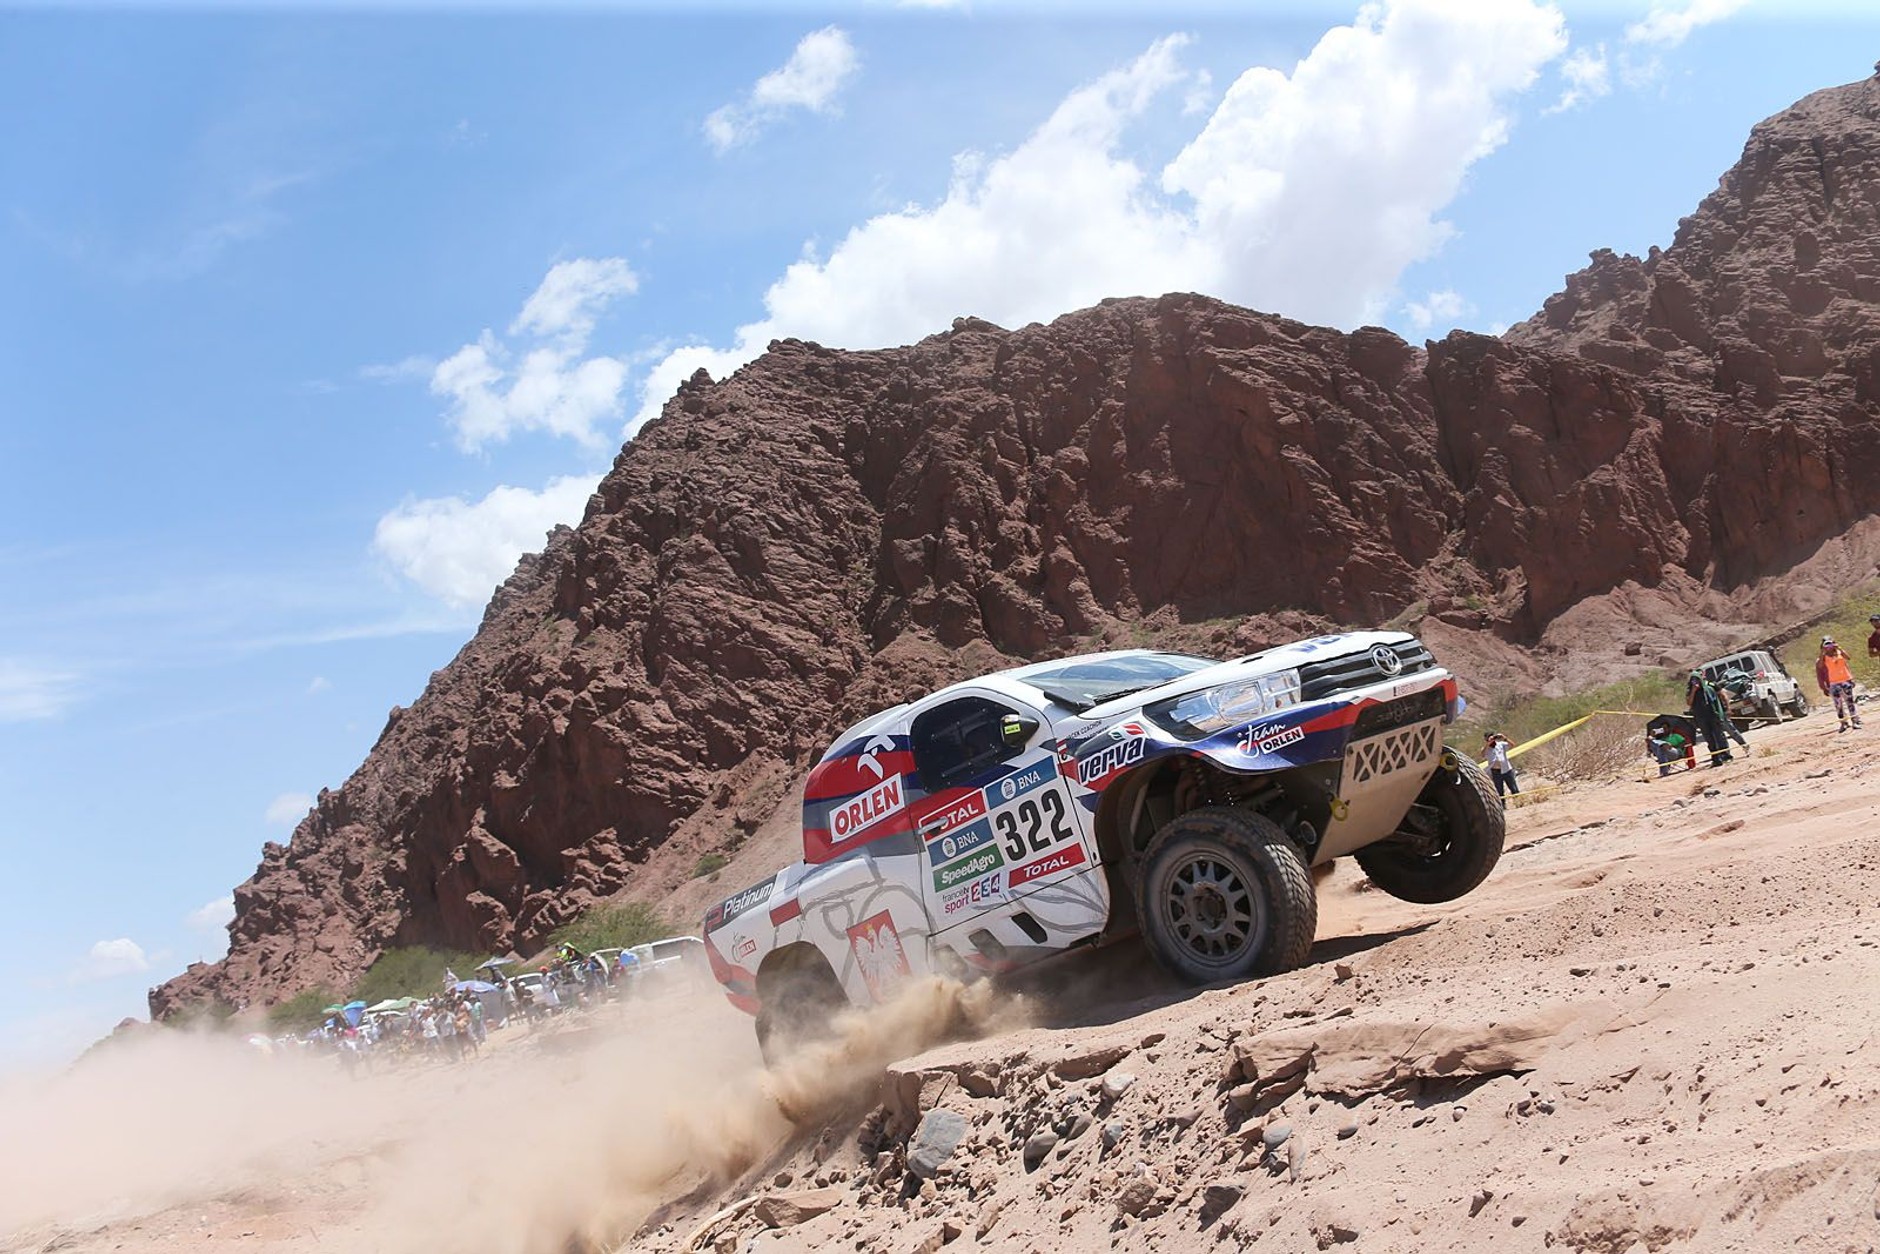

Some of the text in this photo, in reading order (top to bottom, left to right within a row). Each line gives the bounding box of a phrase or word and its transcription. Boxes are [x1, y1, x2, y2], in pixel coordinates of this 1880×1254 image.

[1263, 729, 1302, 751] ORLEN
[1079, 737, 1144, 785] verva
[1017, 770, 1041, 790] BNA
[834, 780, 900, 836] ORLEN
[995, 788, 1074, 862] 322
[956, 831, 980, 850] BNA
[941, 853, 996, 885] SpeedAgro
[1023, 855, 1070, 878] TOTAL
[723, 882, 774, 920] Platinum
[944, 894, 970, 915] sport
